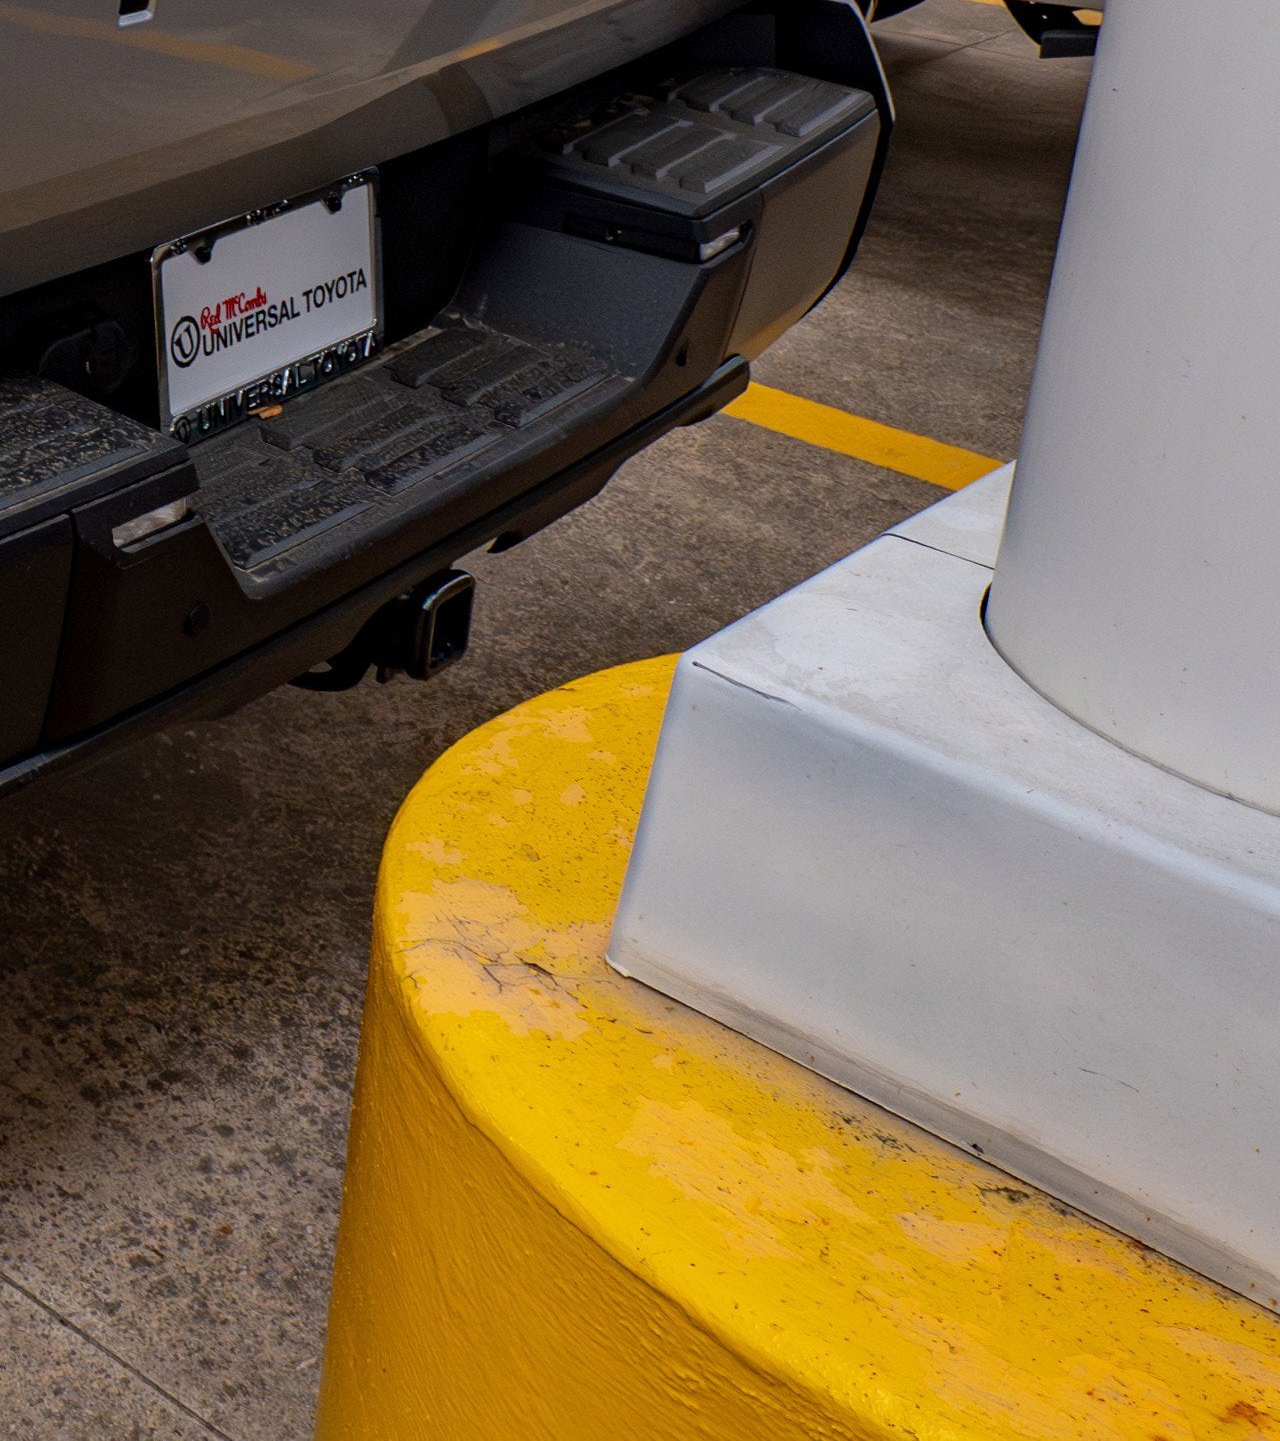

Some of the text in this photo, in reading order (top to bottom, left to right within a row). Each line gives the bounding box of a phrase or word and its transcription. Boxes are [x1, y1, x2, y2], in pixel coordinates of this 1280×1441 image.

[201, 302, 222, 334] Red
[202, 296, 301, 356] UNIVERSAL
[303, 269, 368, 313] TOYOTA
[198, 330, 378, 431] UNIVERSAL TOYOTA
